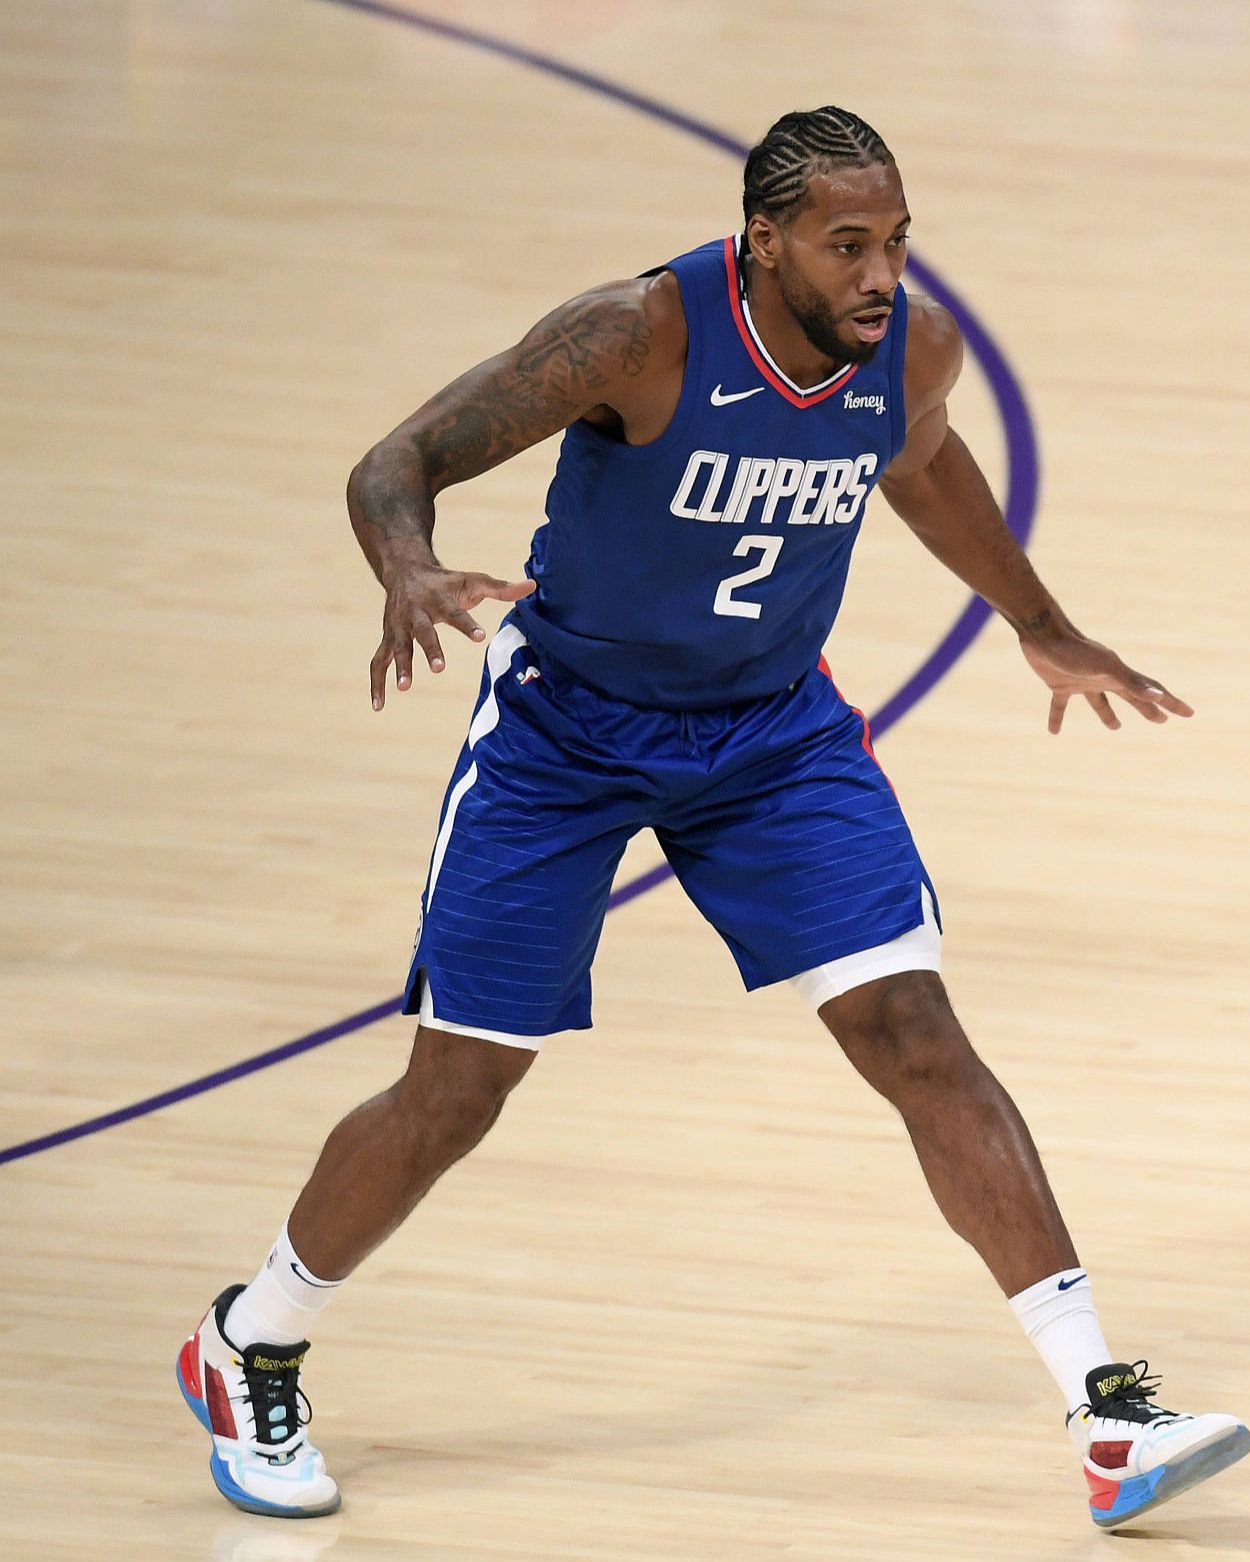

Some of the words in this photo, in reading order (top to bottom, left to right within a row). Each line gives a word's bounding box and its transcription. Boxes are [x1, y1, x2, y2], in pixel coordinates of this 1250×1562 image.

[843, 390, 886, 415] honey
[669, 449, 878, 525] CLIPPERS
[713, 534, 785, 620] 2
